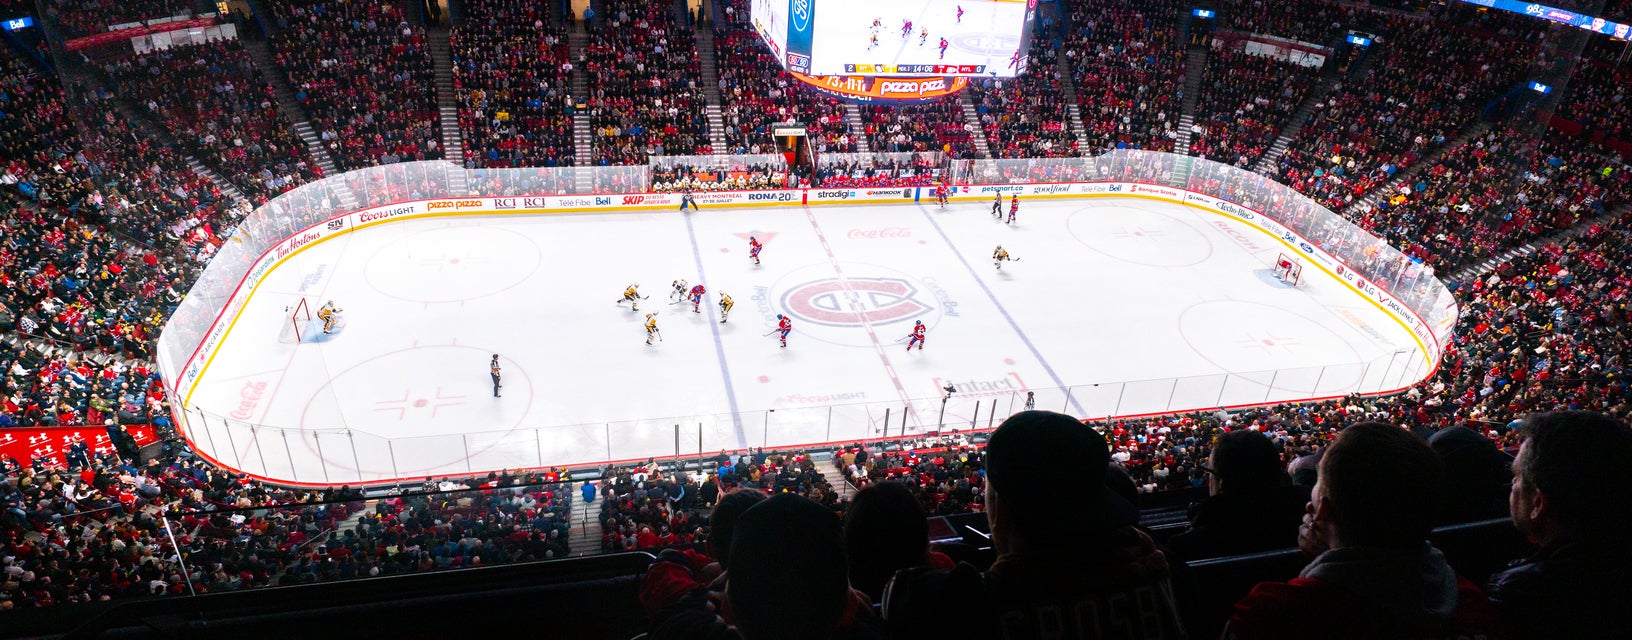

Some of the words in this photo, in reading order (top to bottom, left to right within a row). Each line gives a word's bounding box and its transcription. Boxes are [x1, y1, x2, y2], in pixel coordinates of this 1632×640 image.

[9, 18, 25, 28] Bell
[880, 81, 919, 96] pizza
[919, 80, 946, 96] pizz
[981, 185, 1024, 193] petsmart.ca
[1034, 184, 1071, 194] goodfood
[1108, 184, 1122, 192] Bell
[748, 193, 777, 201] RONA
[817, 189, 849, 199] stradigi
[427, 201, 454, 211] pizza
[455, 200, 483, 210] pizza
[494, 198, 517, 209] RCI
[524, 197, 546, 208] RCI
[574, 198, 591, 207] Fibe
[595, 196, 611, 206] Bell
[622, 195, 645, 205] SKIP
[359, 210, 389, 223] Coors
[389, 205, 415, 216] LIGHT
[1284, 231, 1297, 244] Bell
[275, 244, 290, 260] Tim
[289, 231, 321, 252] Hortons
[1387, 300, 1401, 313] JACK
[187, 362, 199, 383] Bell
